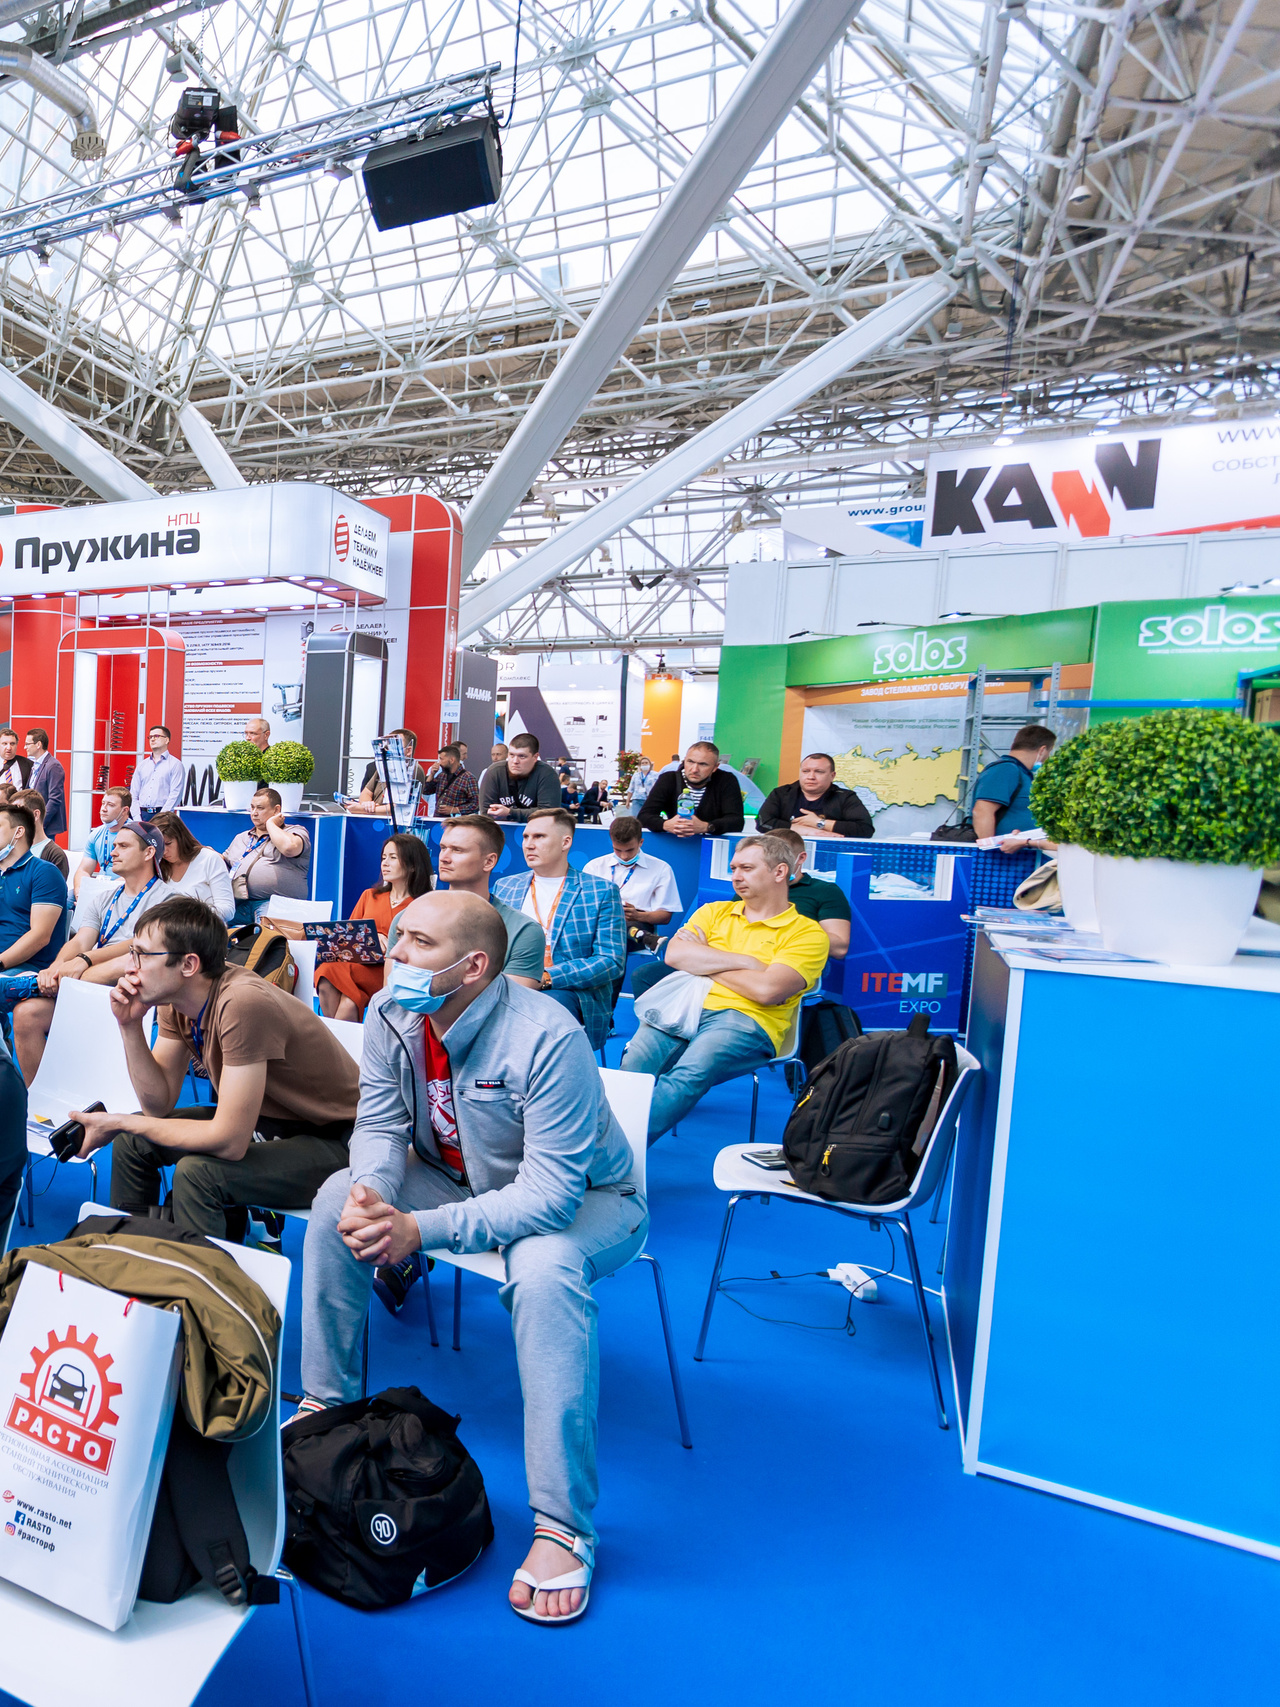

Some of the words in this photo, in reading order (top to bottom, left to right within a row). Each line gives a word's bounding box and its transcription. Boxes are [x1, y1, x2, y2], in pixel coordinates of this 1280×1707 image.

[167, 512, 201, 527] НПЦ
[848, 504, 926, 517] www.grou
[353, 524, 377, 543] ДЕЛАЕМ
[15, 528, 201, 574] Пружина
[353, 540, 378, 559] ТЕХНИКУ
[352, 556, 384, 577] НАДЁЖНЕЕ!
[1138, 605, 1280, 646] solos
[873, 631, 967, 675] solos
[860, 687, 884, 697] ЗАВОД
[884, 682, 937, 695] СТЕЛЛАЖНОГО
[861, 972, 943, 993] ITEMF
[899, 1001, 942, 1014] EXPO
[14, 1406, 101, 1462] РАСТО
[1, 1445, 35, 1468] СТАНЦИЙ
[36, 1463, 98, 1496] ТЕХНИЧЕСКОГО
[12, 1463, 77, 1498] ОБСЛУЖИВАНИЯ
[51, 1459, 109, 1489] АССОЦИАЦИЯ
[16, 1499, 72, 1530] www.rasto.net
[26, 1517, 52, 1536] RASTO
[376, 1519, 390, 1539] 90
[17, 1528, 56, 1552] #расторф
